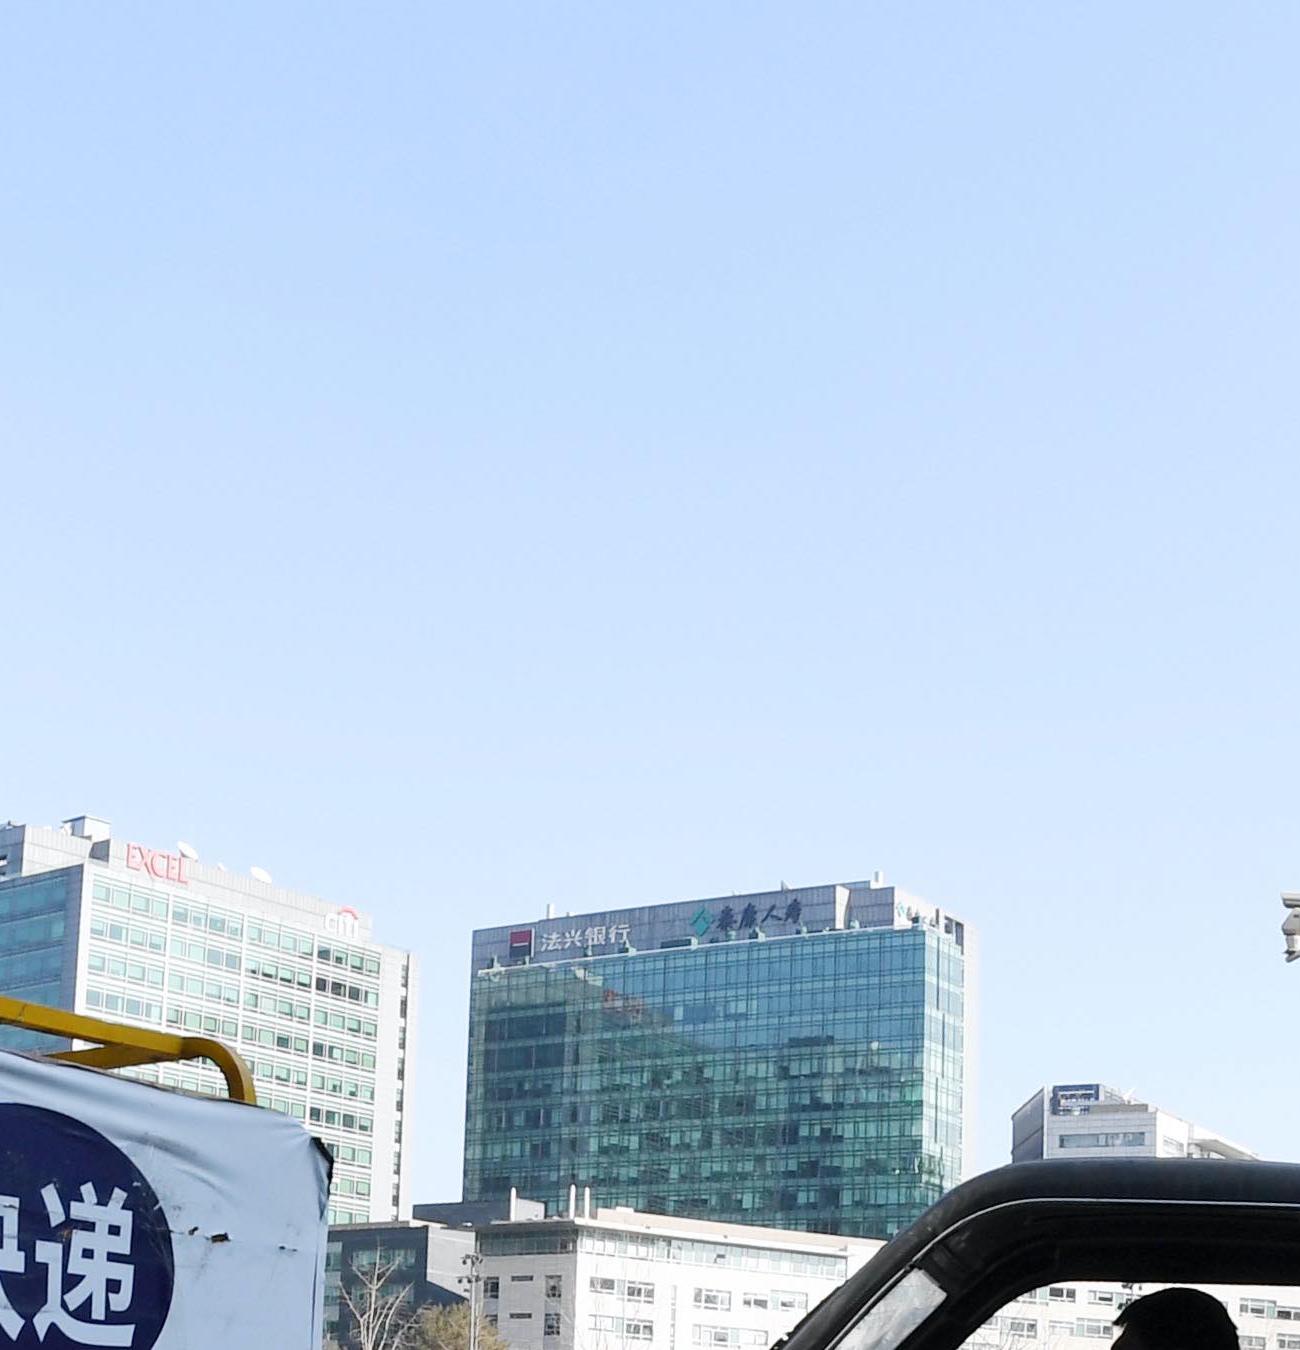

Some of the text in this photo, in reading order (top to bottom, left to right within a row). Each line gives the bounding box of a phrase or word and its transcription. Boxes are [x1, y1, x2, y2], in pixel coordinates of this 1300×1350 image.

[126, 843, 188, 885] EXCEL
[539, 924, 631, 952] 法兴银行
